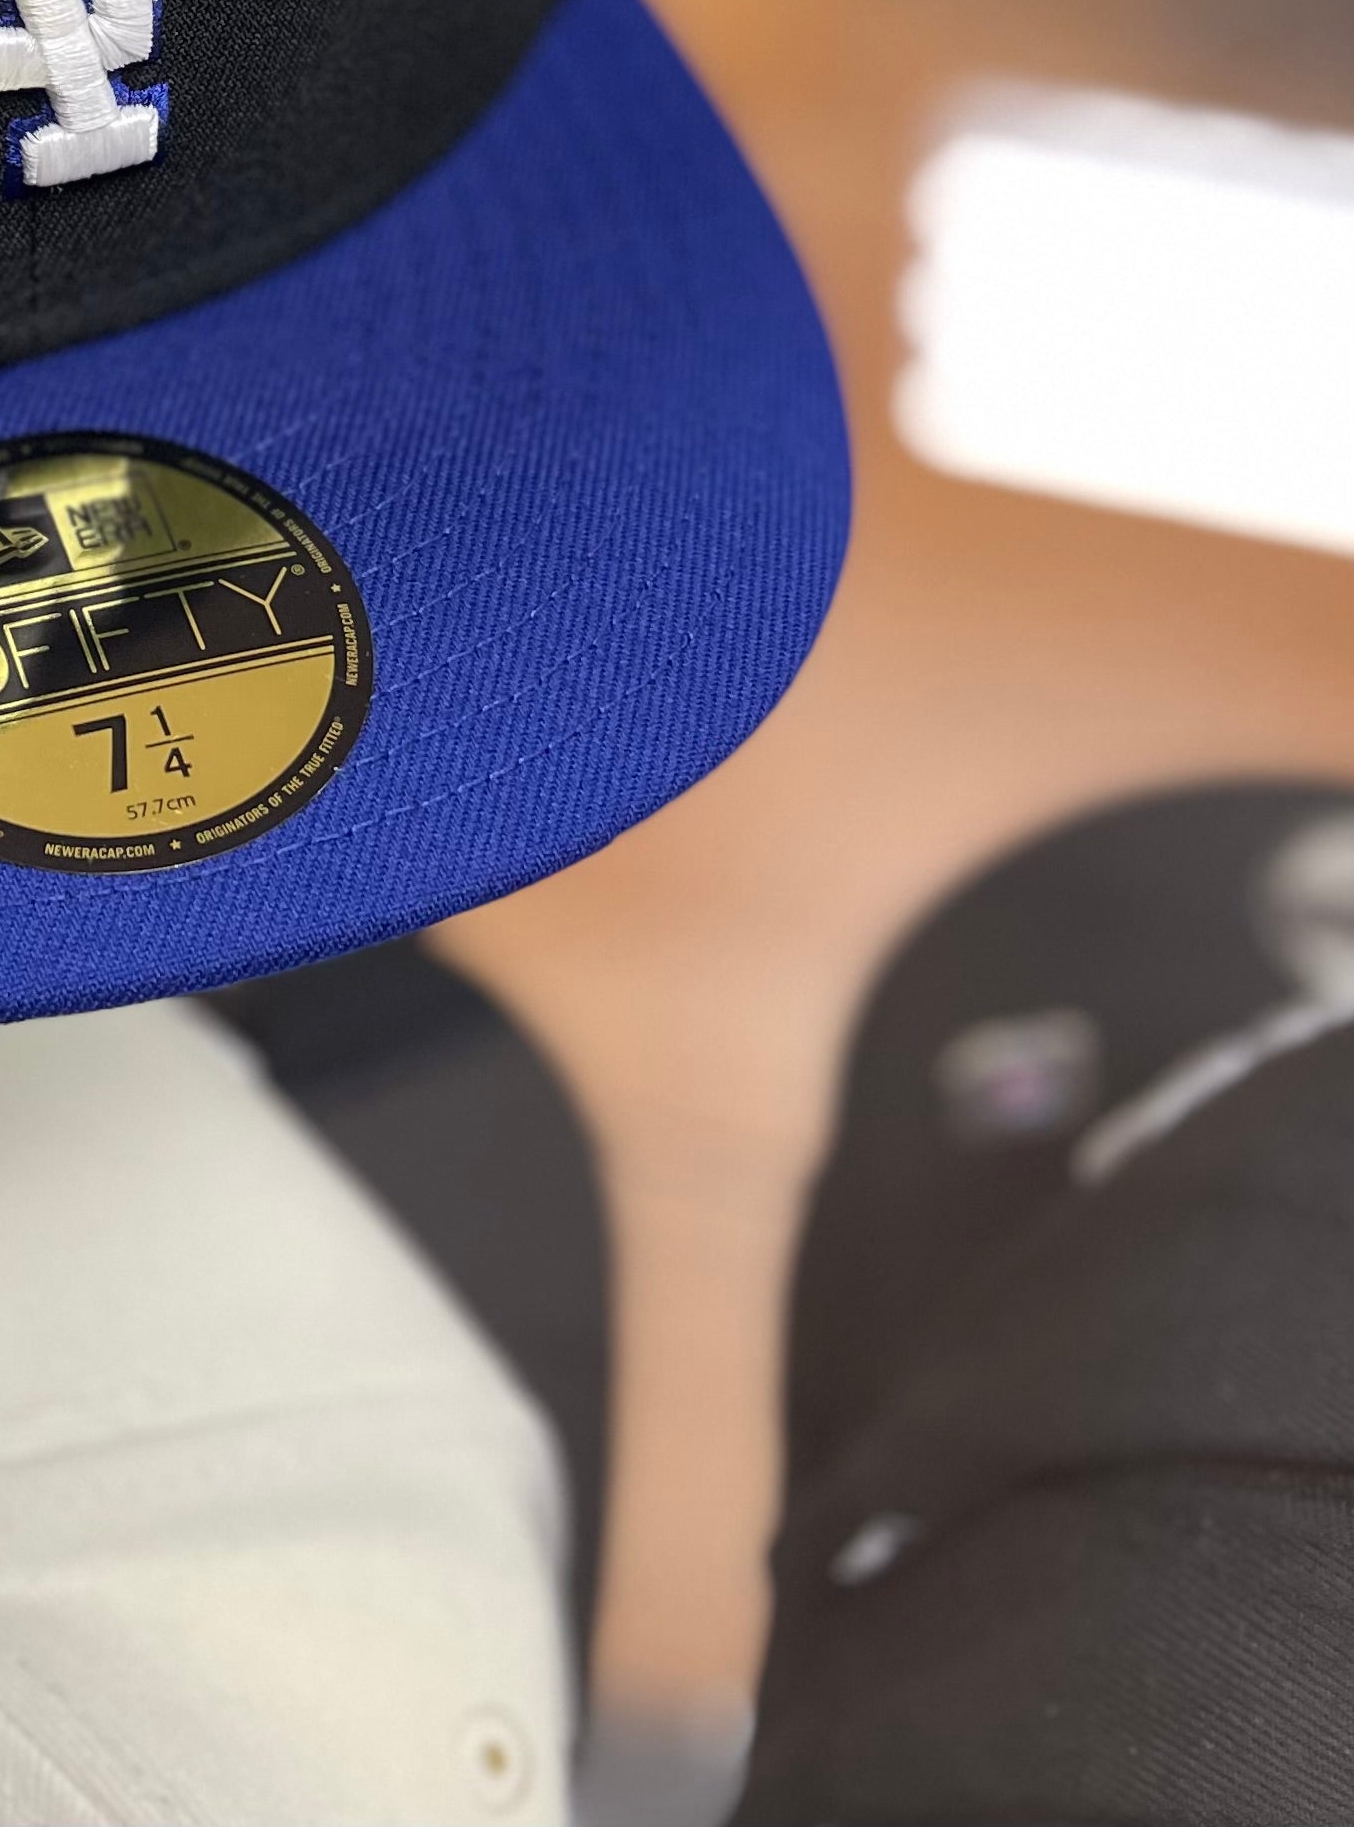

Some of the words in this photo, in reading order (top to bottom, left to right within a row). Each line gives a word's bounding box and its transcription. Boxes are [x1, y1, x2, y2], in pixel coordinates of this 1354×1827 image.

[65, 496, 144, 528] NEW
[337, 603, 359, 687] NEWERACAP.COM
[72, 713, 128, 794] 7
[126, 794, 196, 820] 57.7cm
[195, 804, 269, 845] ORIGINATORS
[267, 792, 283, 808] OF
[281, 775, 304, 796] THE
[299, 752, 325, 778] TRUE
[44, 842, 156, 860] NEWERACAP.COM
